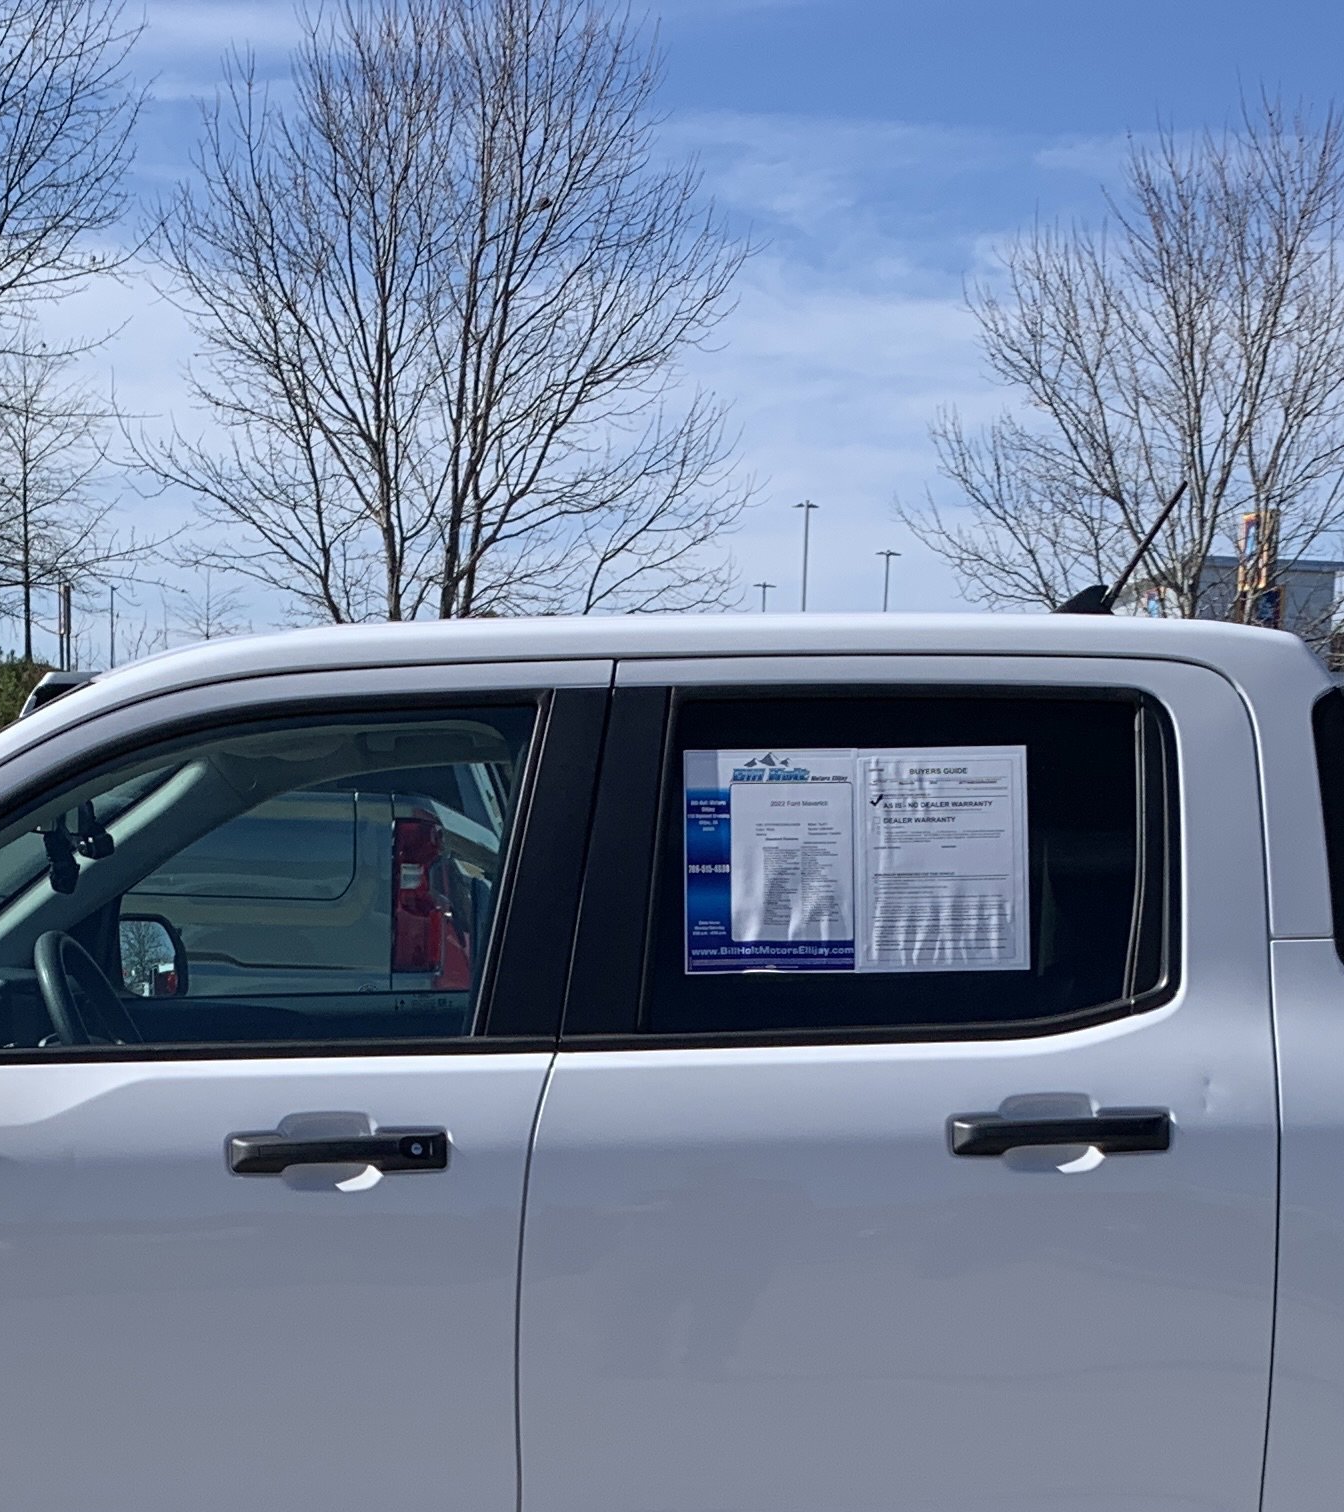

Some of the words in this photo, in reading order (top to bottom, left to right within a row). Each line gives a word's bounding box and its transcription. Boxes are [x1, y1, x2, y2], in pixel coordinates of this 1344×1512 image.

[909, 767, 942, 775] BUYERS
[942, 767, 969, 775] GUIDE
[951, 800, 993, 808] WARRANTY
[883, 816, 913, 824] DEALER
